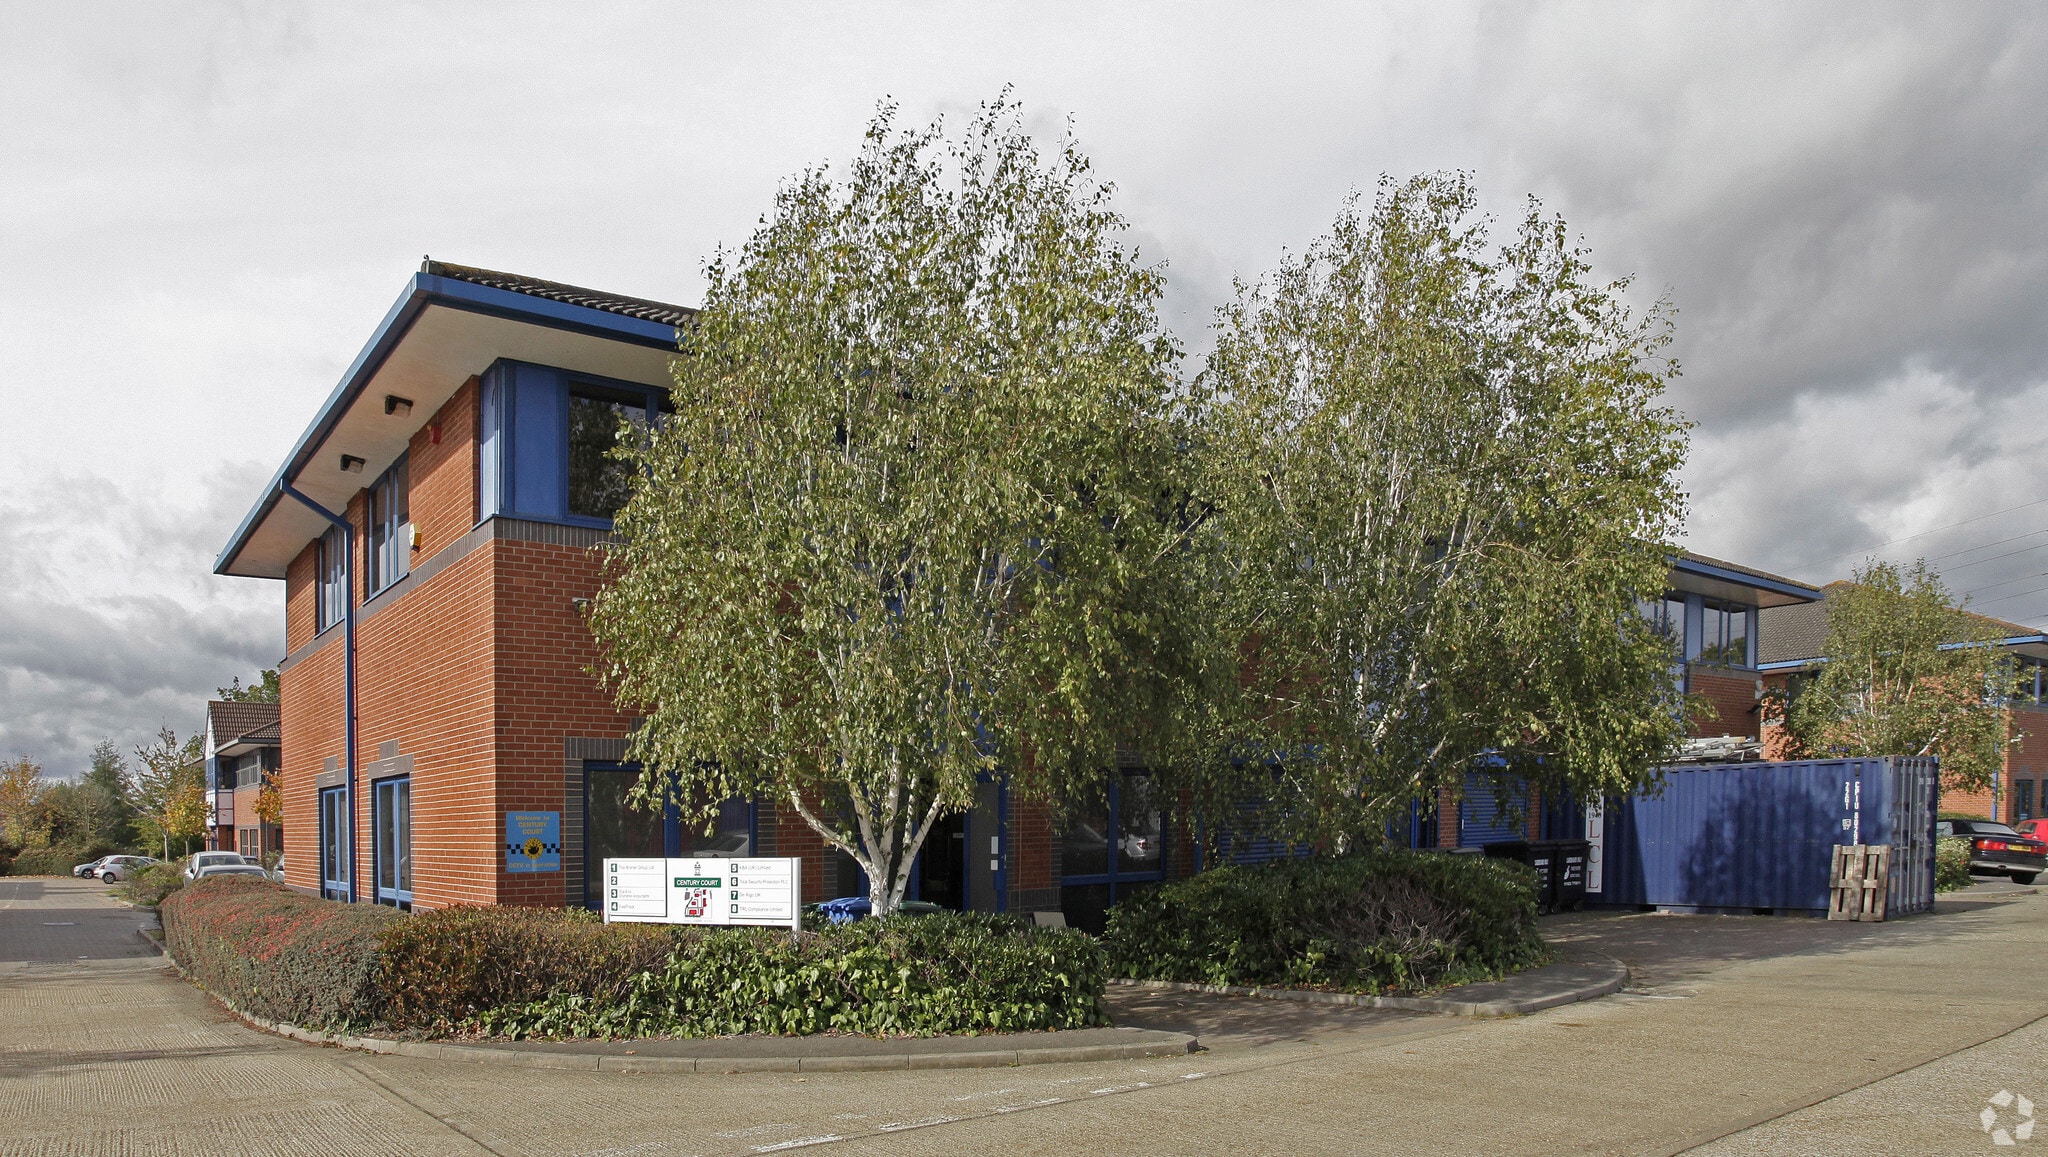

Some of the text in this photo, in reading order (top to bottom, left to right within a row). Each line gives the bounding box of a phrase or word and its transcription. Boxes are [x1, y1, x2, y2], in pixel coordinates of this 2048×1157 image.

[731, 864, 737, 872] 5
[611, 876, 617, 885] 2
[731, 878, 737, 886] 6
[611, 889, 617, 898] 3
[731, 891, 737, 899] 7
[611, 902, 617, 911] 4
[731, 905, 737, 913] 8
